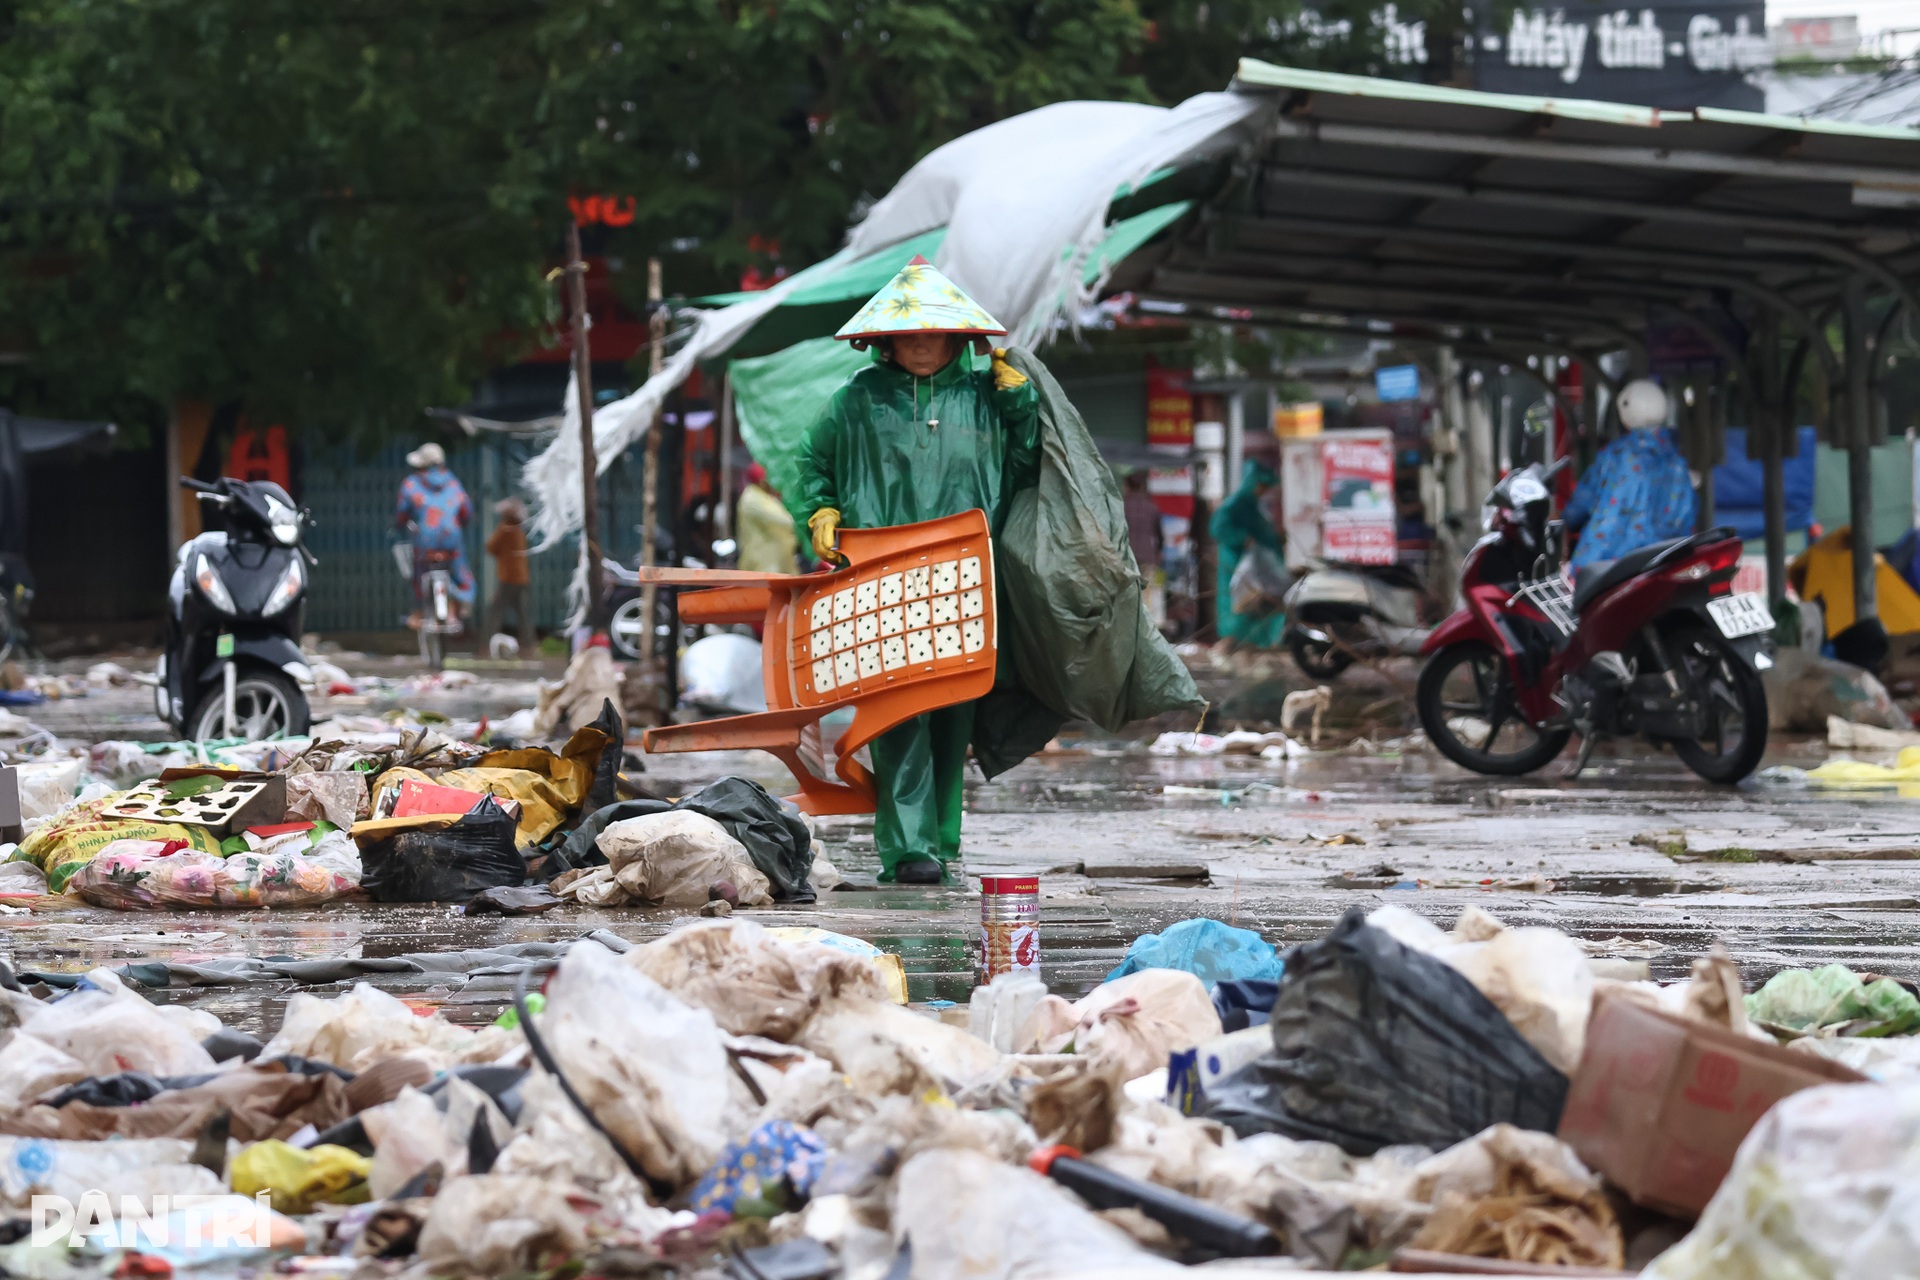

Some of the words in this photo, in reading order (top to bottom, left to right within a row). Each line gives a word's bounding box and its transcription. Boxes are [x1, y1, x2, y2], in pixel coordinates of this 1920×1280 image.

[1508, 8, 1588, 84] Máy
[1597, 9, 1664, 69] tính
[78, 835, 108, 850] TNHH
[110, 831, 126, 842] TY
